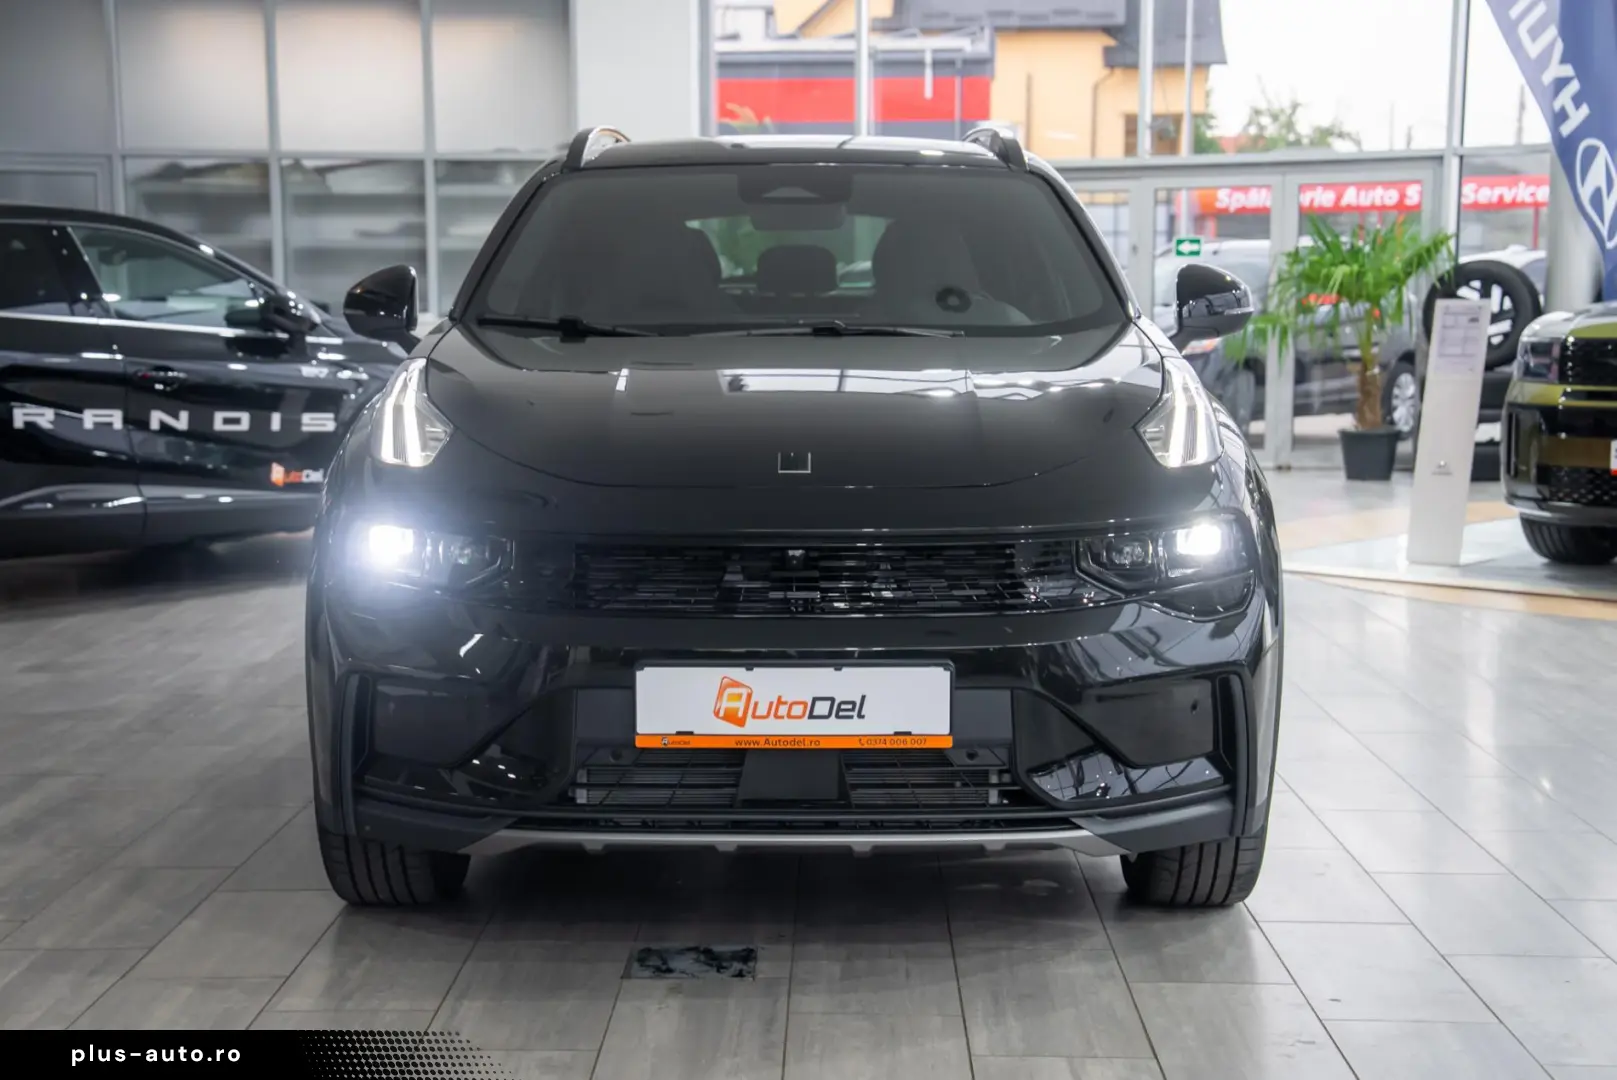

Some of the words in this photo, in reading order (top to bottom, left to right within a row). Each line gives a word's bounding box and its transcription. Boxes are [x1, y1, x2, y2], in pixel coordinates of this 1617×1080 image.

[1340, 185, 1401, 207] Auto
[1461, 180, 1550, 204] Service
[713, 676, 867, 728] AutoDel
[735, 737, 821, 747] www.Autodel.ro
[866, 738, 887, 746] 0374
[890, 738, 908, 746] 006
[910, 738, 927, 746] 007
